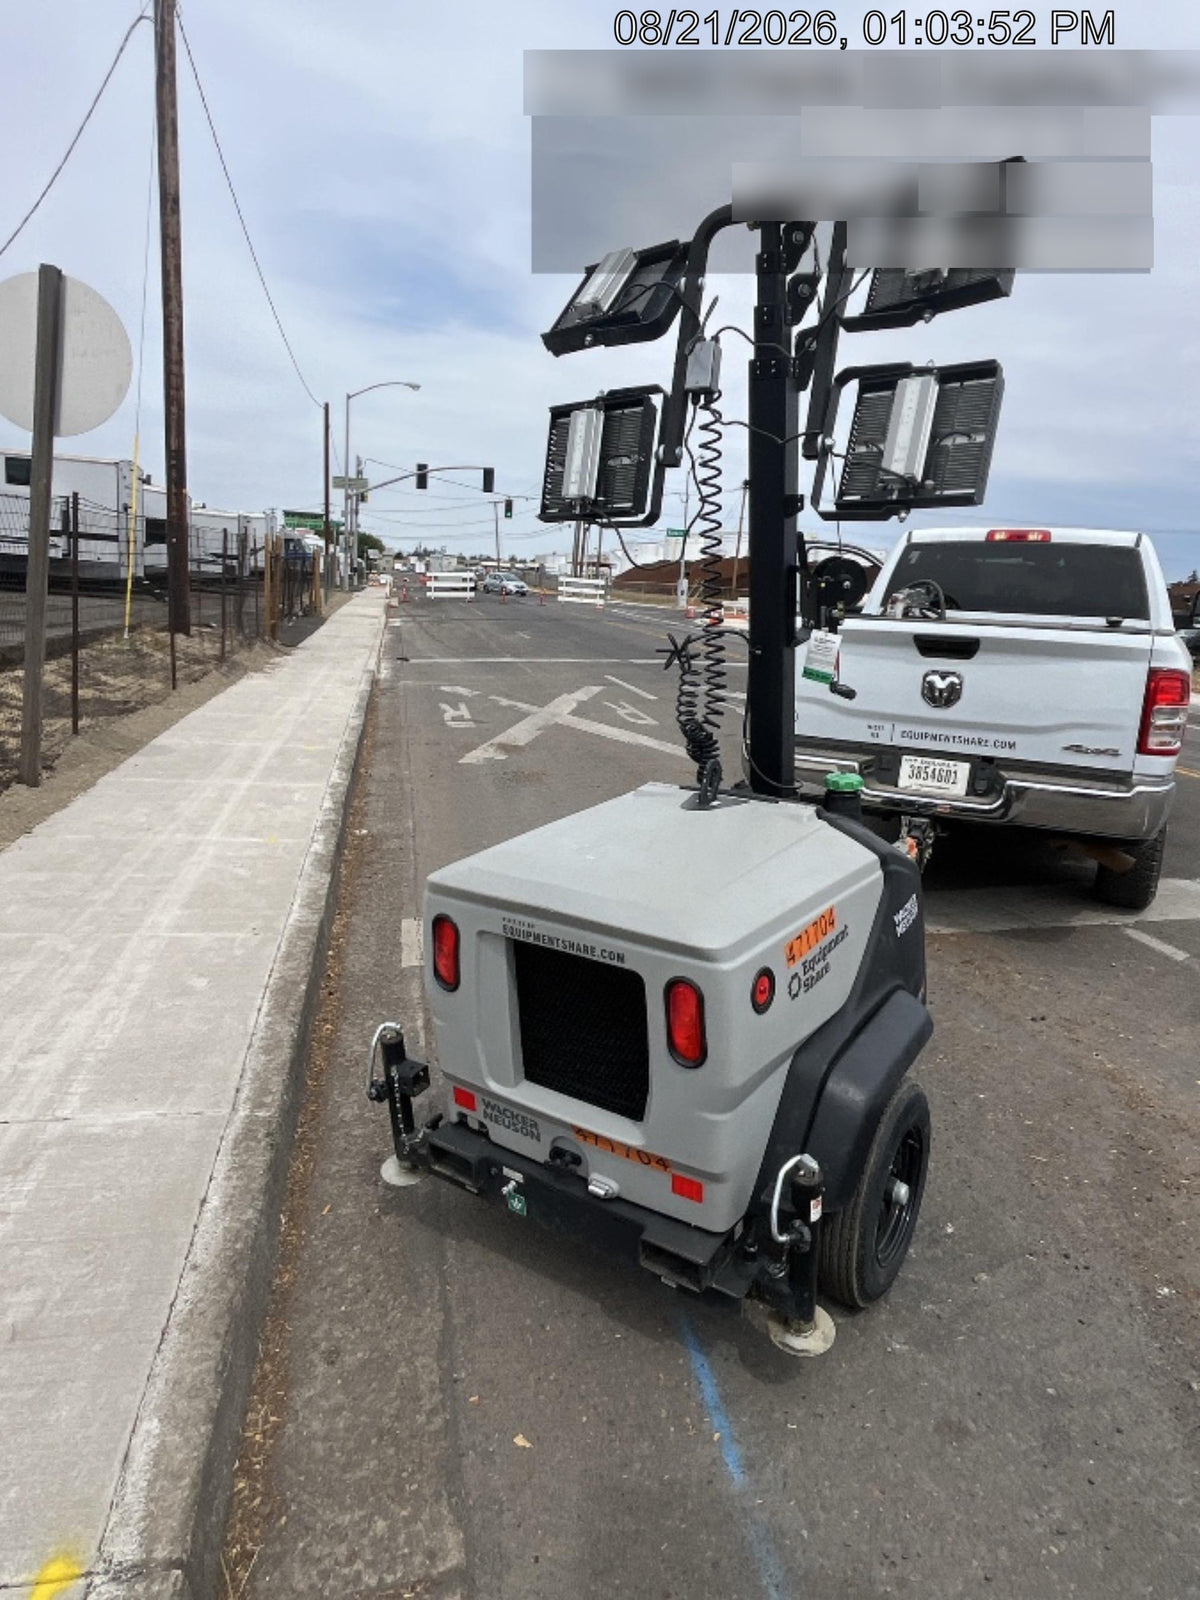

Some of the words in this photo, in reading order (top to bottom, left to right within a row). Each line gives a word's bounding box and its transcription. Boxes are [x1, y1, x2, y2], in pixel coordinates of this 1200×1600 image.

[900, 730, 1017, 750] EQUIPMENTSHARE.COM
[502, 924, 625, 964] EQUIPMENTSHARE.COM
[786, 908, 836, 965] 471704
[482, 1098, 540, 1130] WACKER
[483, 1109, 541, 1142] NEUSON
